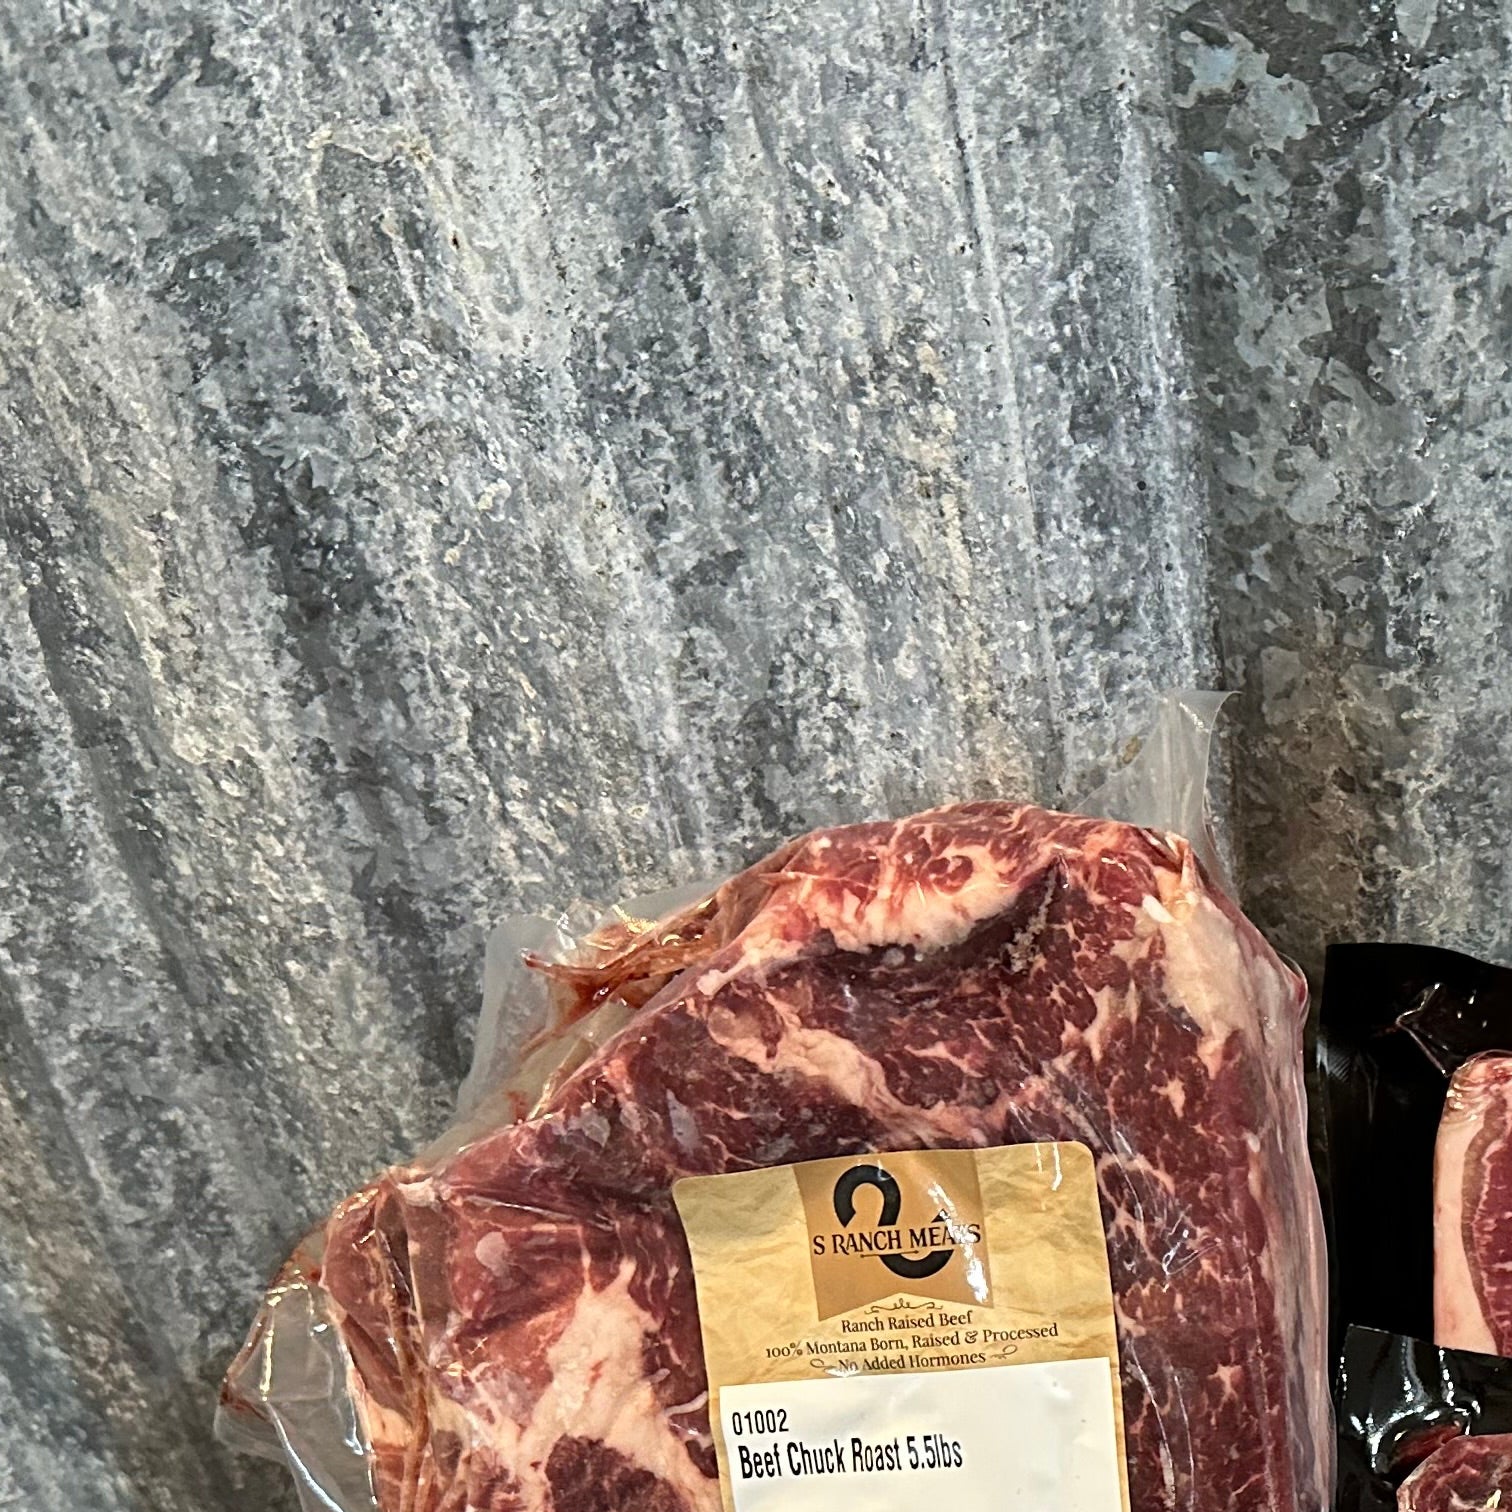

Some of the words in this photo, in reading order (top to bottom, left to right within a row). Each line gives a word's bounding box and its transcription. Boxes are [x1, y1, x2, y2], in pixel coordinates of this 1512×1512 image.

[813, 1236, 825, 1256] S
[832, 1230, 902, 1255] RANCH
[910, 1223, 981, 1247] MEAS
[842, 1319, 884, 1334] Ranch
[888, 1313, 934, 1330] Raised
[939, 1310, 973, 1326] Beef
[766, 1340, 803, 1358] 100%
[806, 1340, 866, 1355] Montana
[870, 1336, 908, 1352] Born,
[912, 1330, 960, 1349] Raised
[964, 1330, 979, 1344] &
[983, 1323, 1058, 1343] Processed
[862, 1354, 906, 1371] Added
[909, 1352, 986, 1368] Hormones
[732, 1408, 789, 1435] 01002
[738, 1442, 782, 1479] Beef
[788, 1439, 846, 1475] Chuck
[851, 1436, 903, 1472] Roast
[907, 1434, 963, 1470] 5.5lbs
